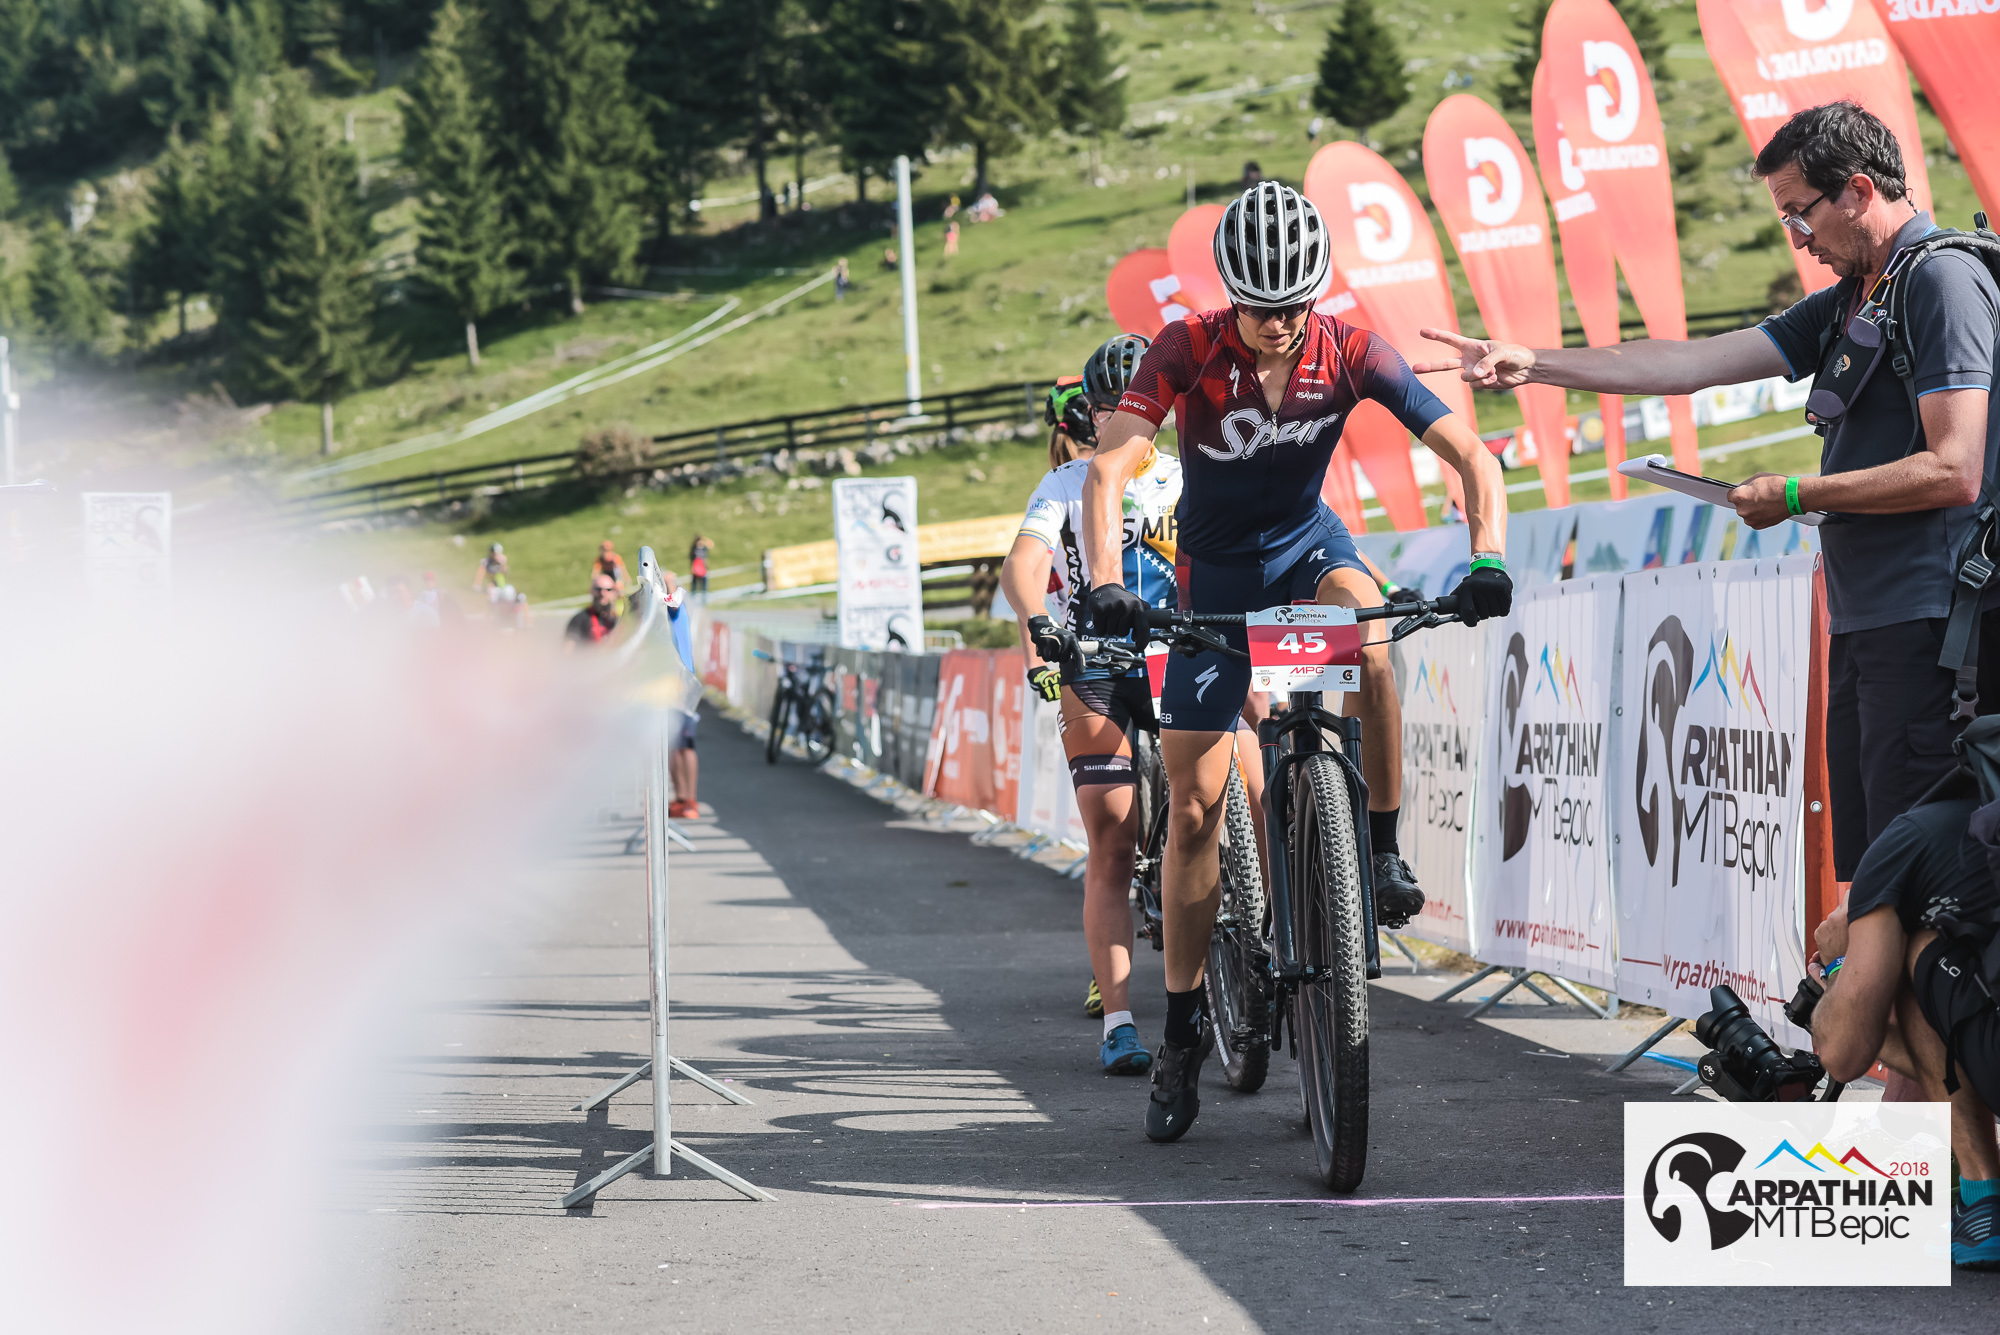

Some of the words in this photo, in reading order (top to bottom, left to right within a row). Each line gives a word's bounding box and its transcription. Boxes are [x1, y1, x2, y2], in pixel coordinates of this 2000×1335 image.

[1296, 391, 1324, 401] RSAWEB
[1198, 408, 1339, 462] Spur
[1158, 504, 1176, 514] tea
[1277, 632, 1327, 654] 45
[1290, 666, 1325, 675] MPG
